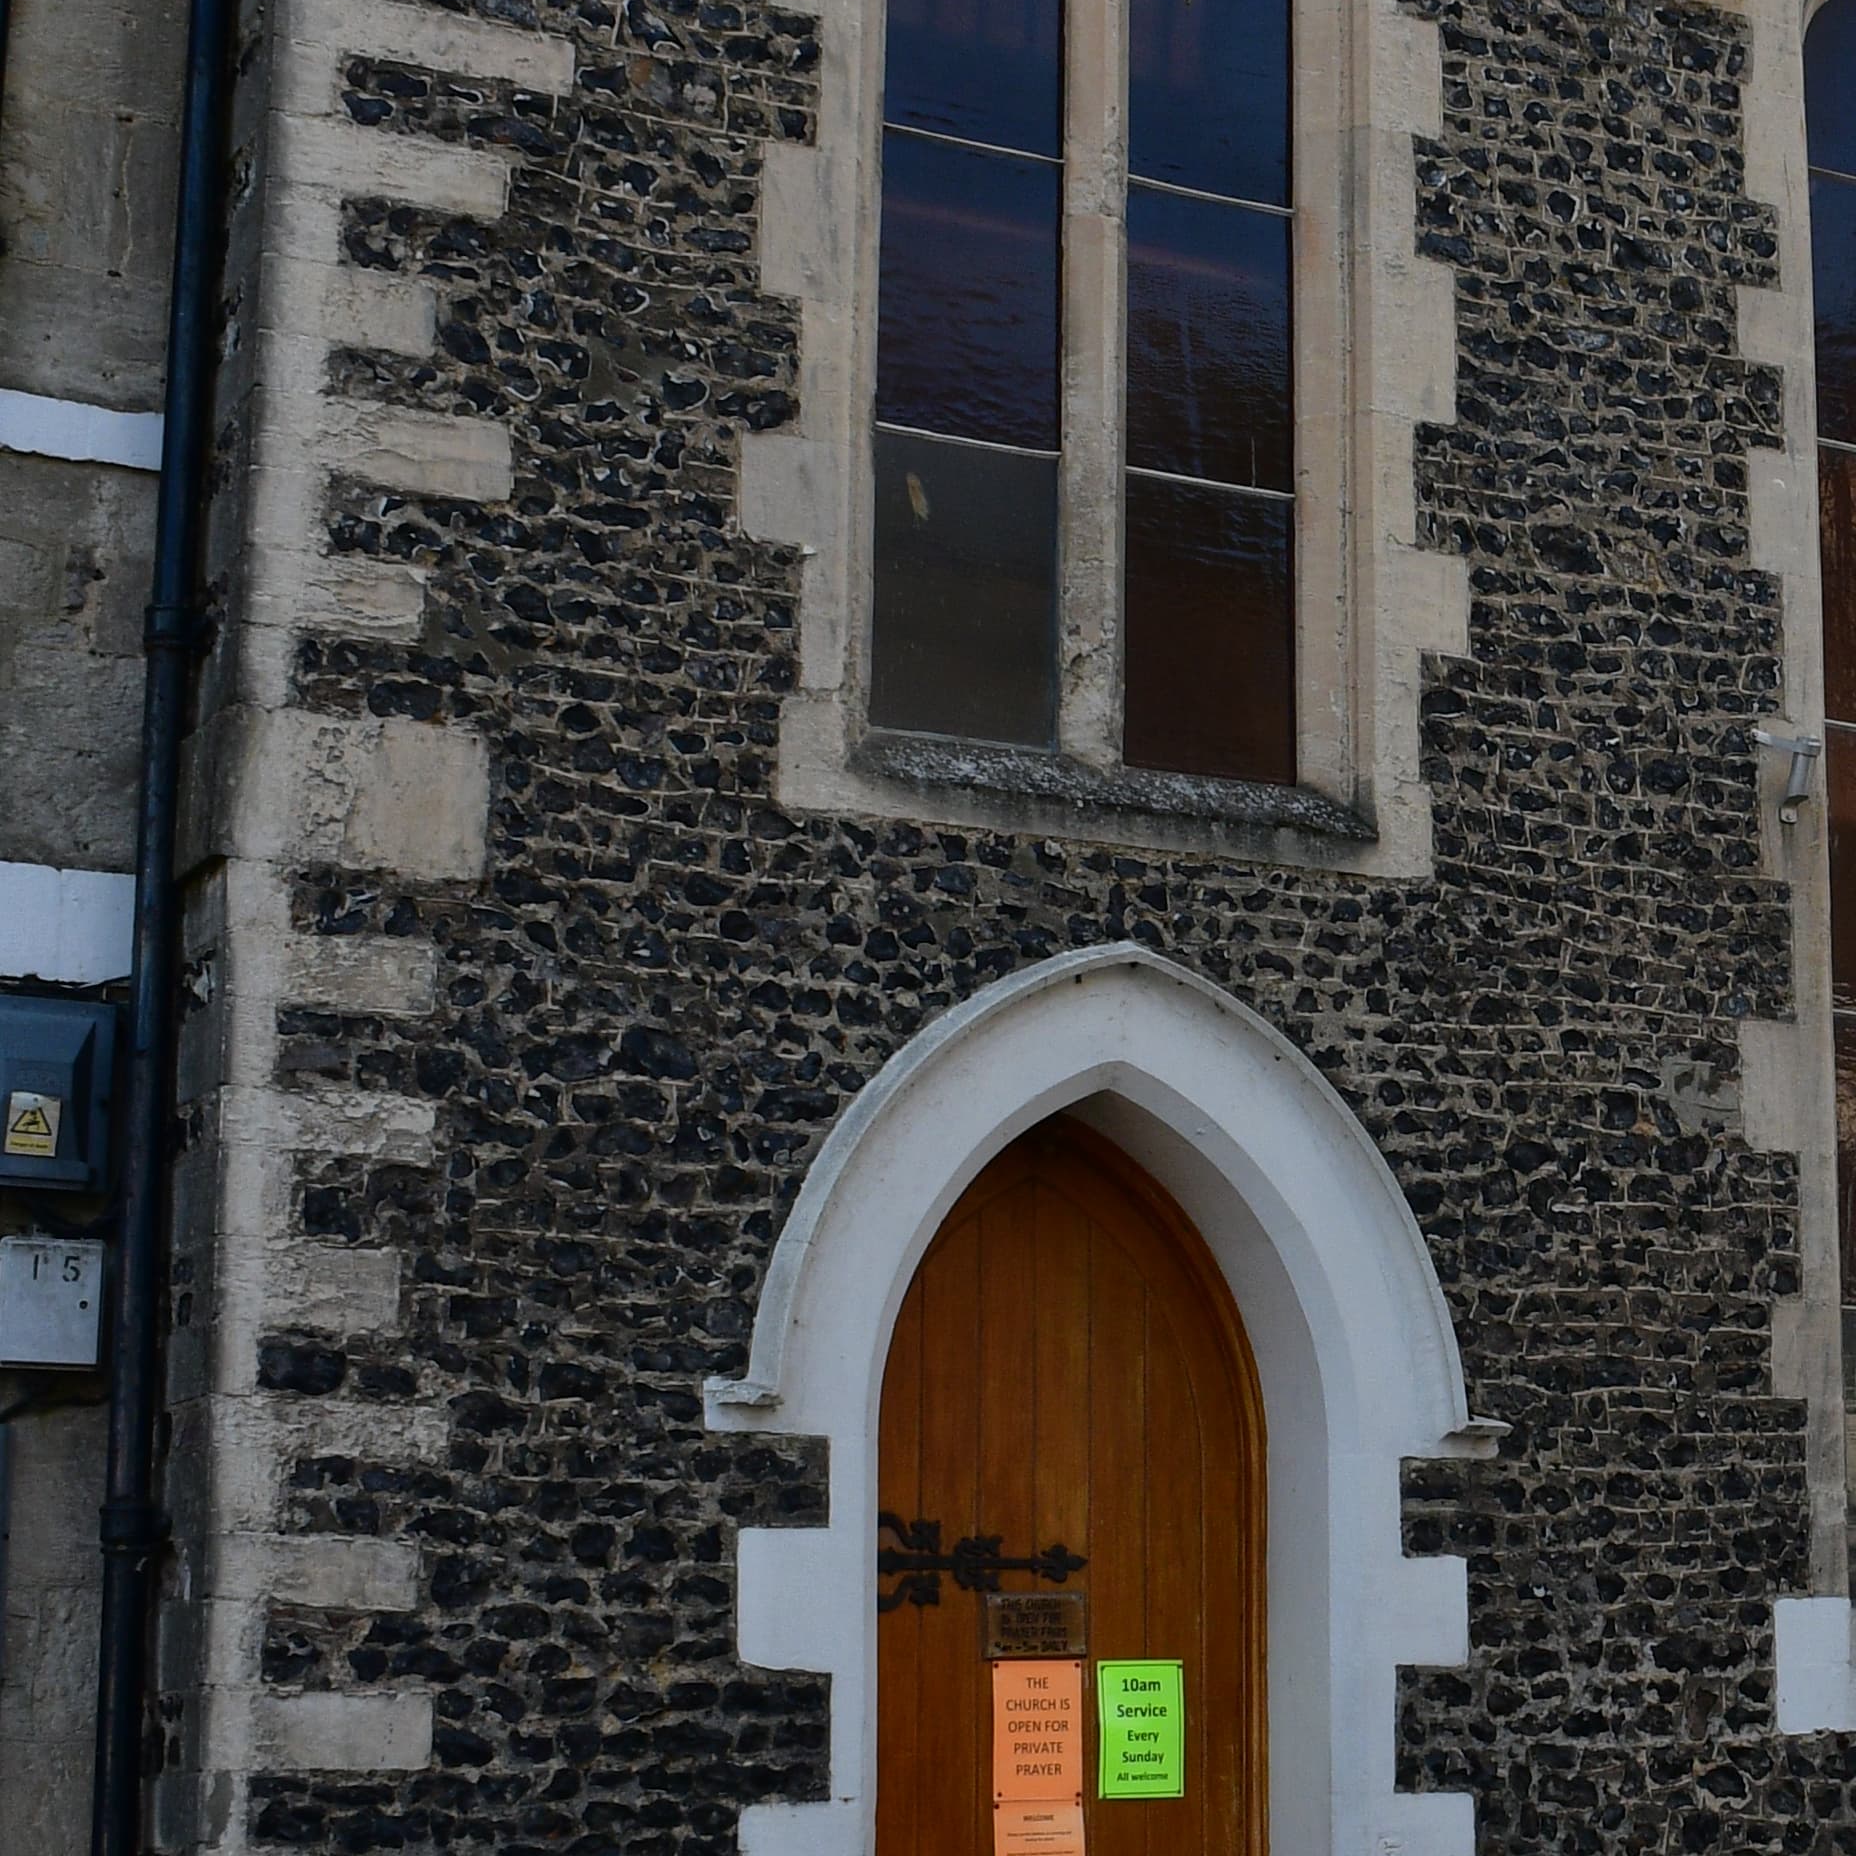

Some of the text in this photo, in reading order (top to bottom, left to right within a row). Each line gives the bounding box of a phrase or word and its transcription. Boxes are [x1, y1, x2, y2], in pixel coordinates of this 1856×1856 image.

[1026, 1677, 1048, 1689] THE
[1121, 1678, 1161, 1692] 10am
[1005, 1699, 1070, 1711] CHURCH IS
[1116, 1704, 1168, 1718] Service
[1008, 1720, 1069, 1733] OPEN FOR
[1127, 1730, 1160, 1744] Every
[1014, 1742, 1063, 1754] PRIVATE
[1122, 1752, 1164, 1765] Sunday
[1016, 1764, 1062, 1776] PRAYER
[1116, 1772, 1169, 1782] All welcome
